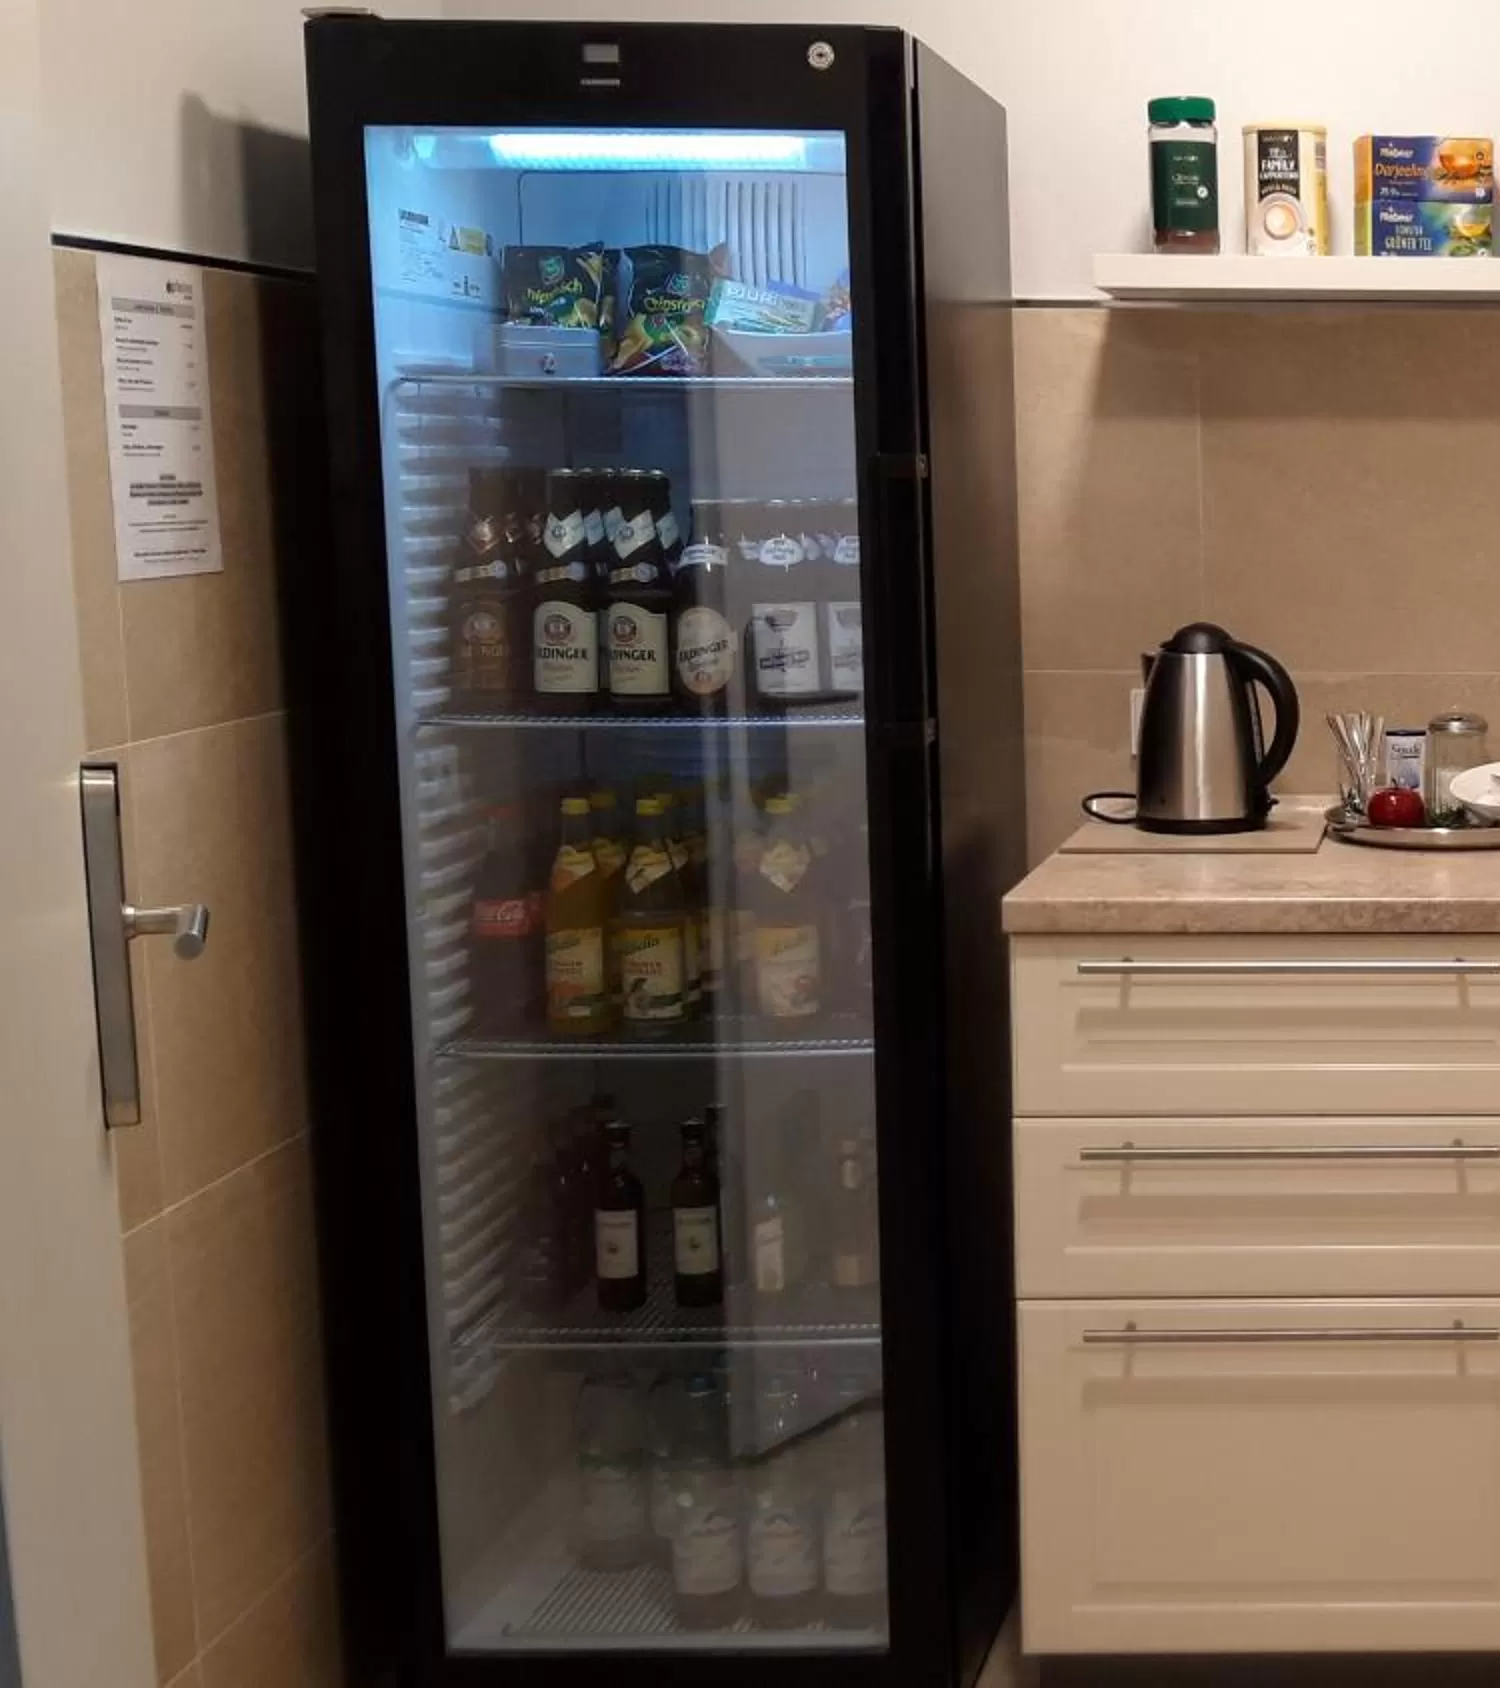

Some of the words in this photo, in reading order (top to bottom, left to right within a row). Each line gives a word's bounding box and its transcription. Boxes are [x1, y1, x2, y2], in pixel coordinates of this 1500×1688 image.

[1261, 159, 1296, 171] FAMILY
[538, 646, 590, 662] DINGER
[609, 648, 658, 662] DINGER
